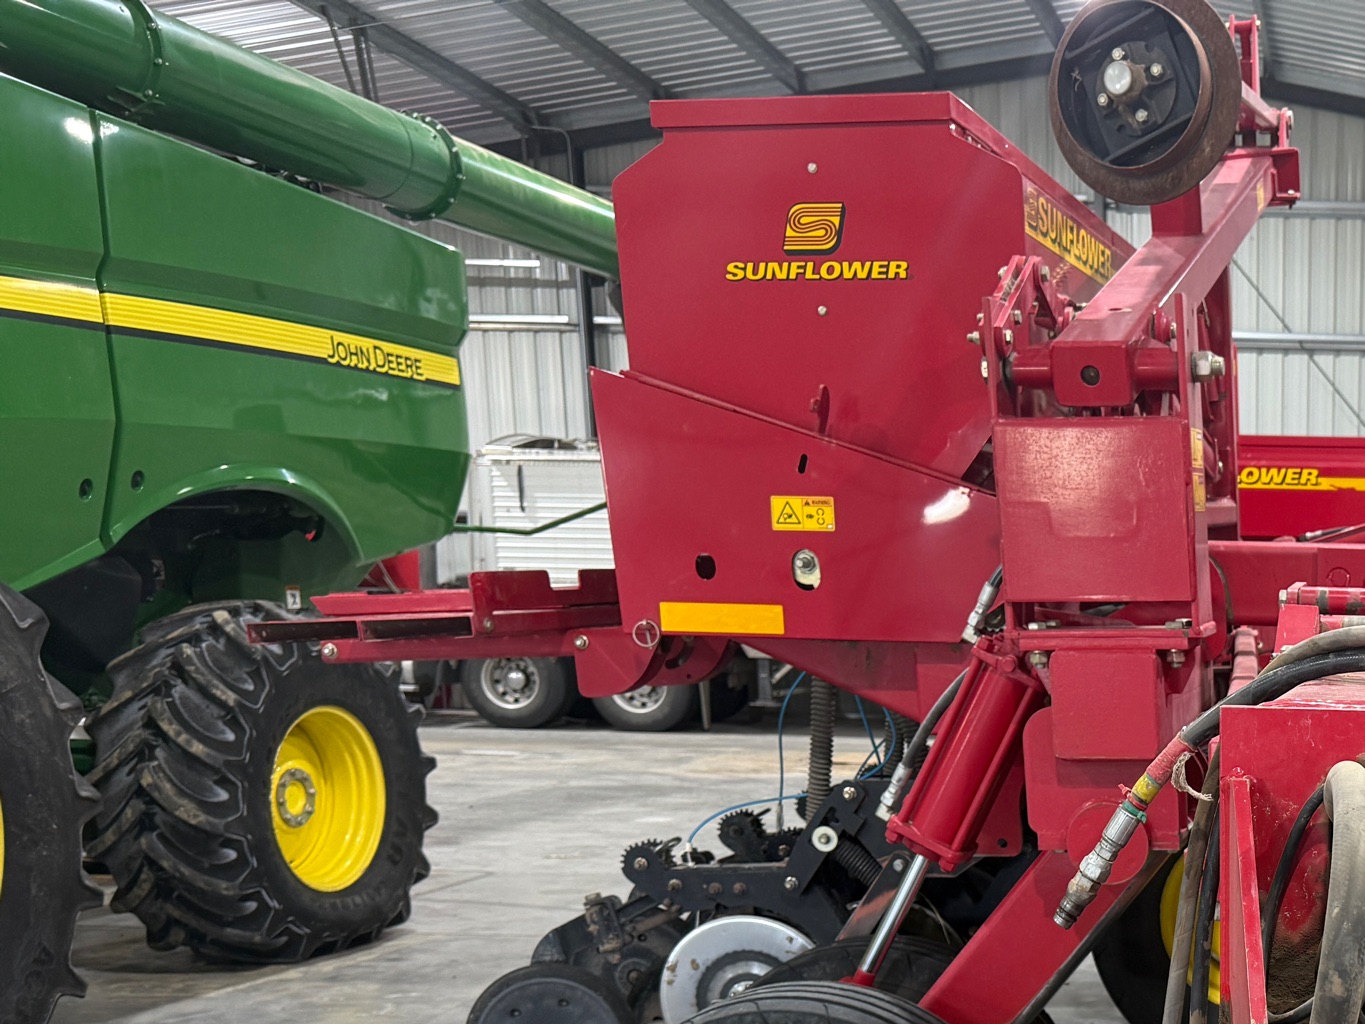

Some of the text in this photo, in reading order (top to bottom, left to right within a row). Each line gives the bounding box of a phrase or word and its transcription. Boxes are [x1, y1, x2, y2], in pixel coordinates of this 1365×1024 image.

[1038, 196, 1112, 278] SUNFLOWER
[725, 260, 909, 281] SUNFLOWER
[327, 335, 426, 378] JOHN DEERE
[1237, 466, 1319, 486] OWER
